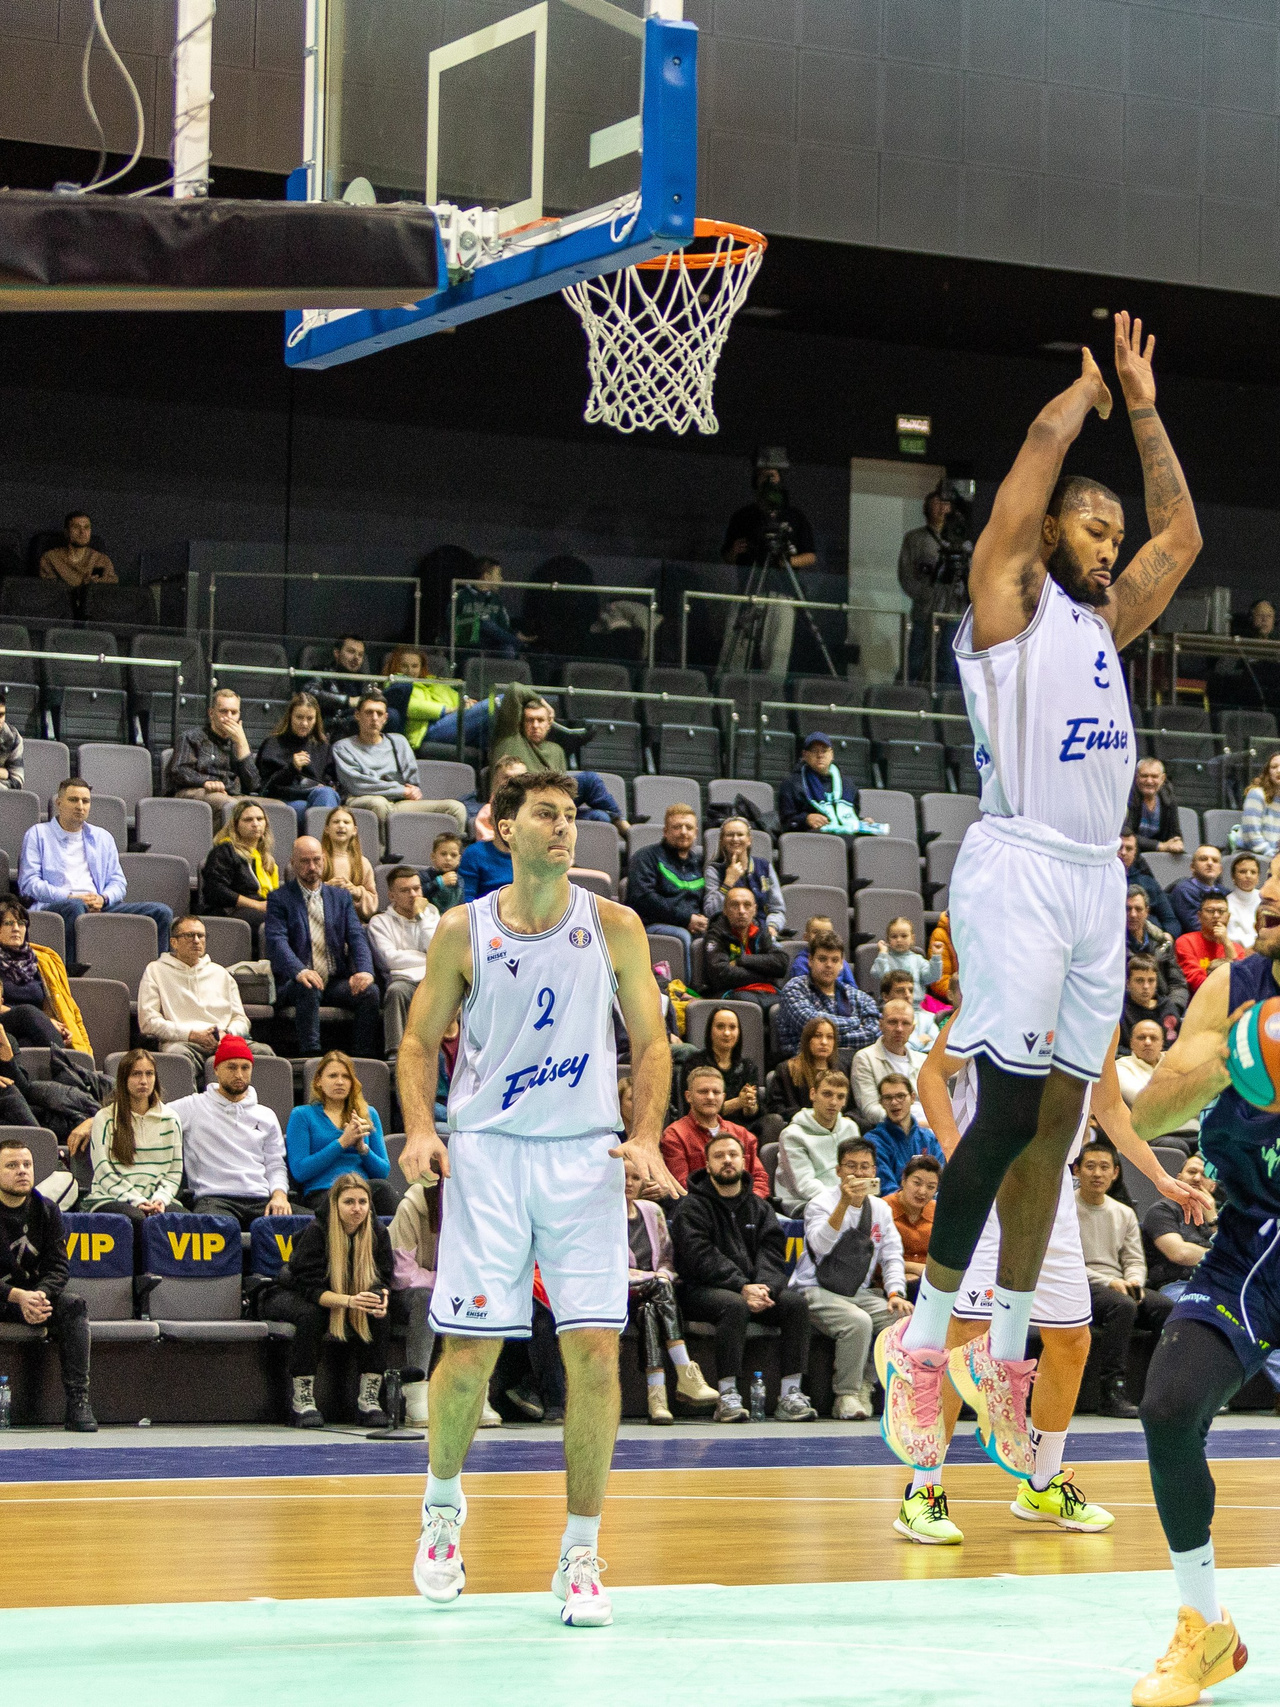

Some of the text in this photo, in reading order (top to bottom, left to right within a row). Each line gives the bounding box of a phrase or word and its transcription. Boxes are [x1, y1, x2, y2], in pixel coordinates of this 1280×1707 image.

[487, 951, 507, 962] ENISEY
[533, 987, 555, 1031] 2
[167, 1231, 226, 1260] VIP
[466, 1310, 488, 1318] ENISEY
